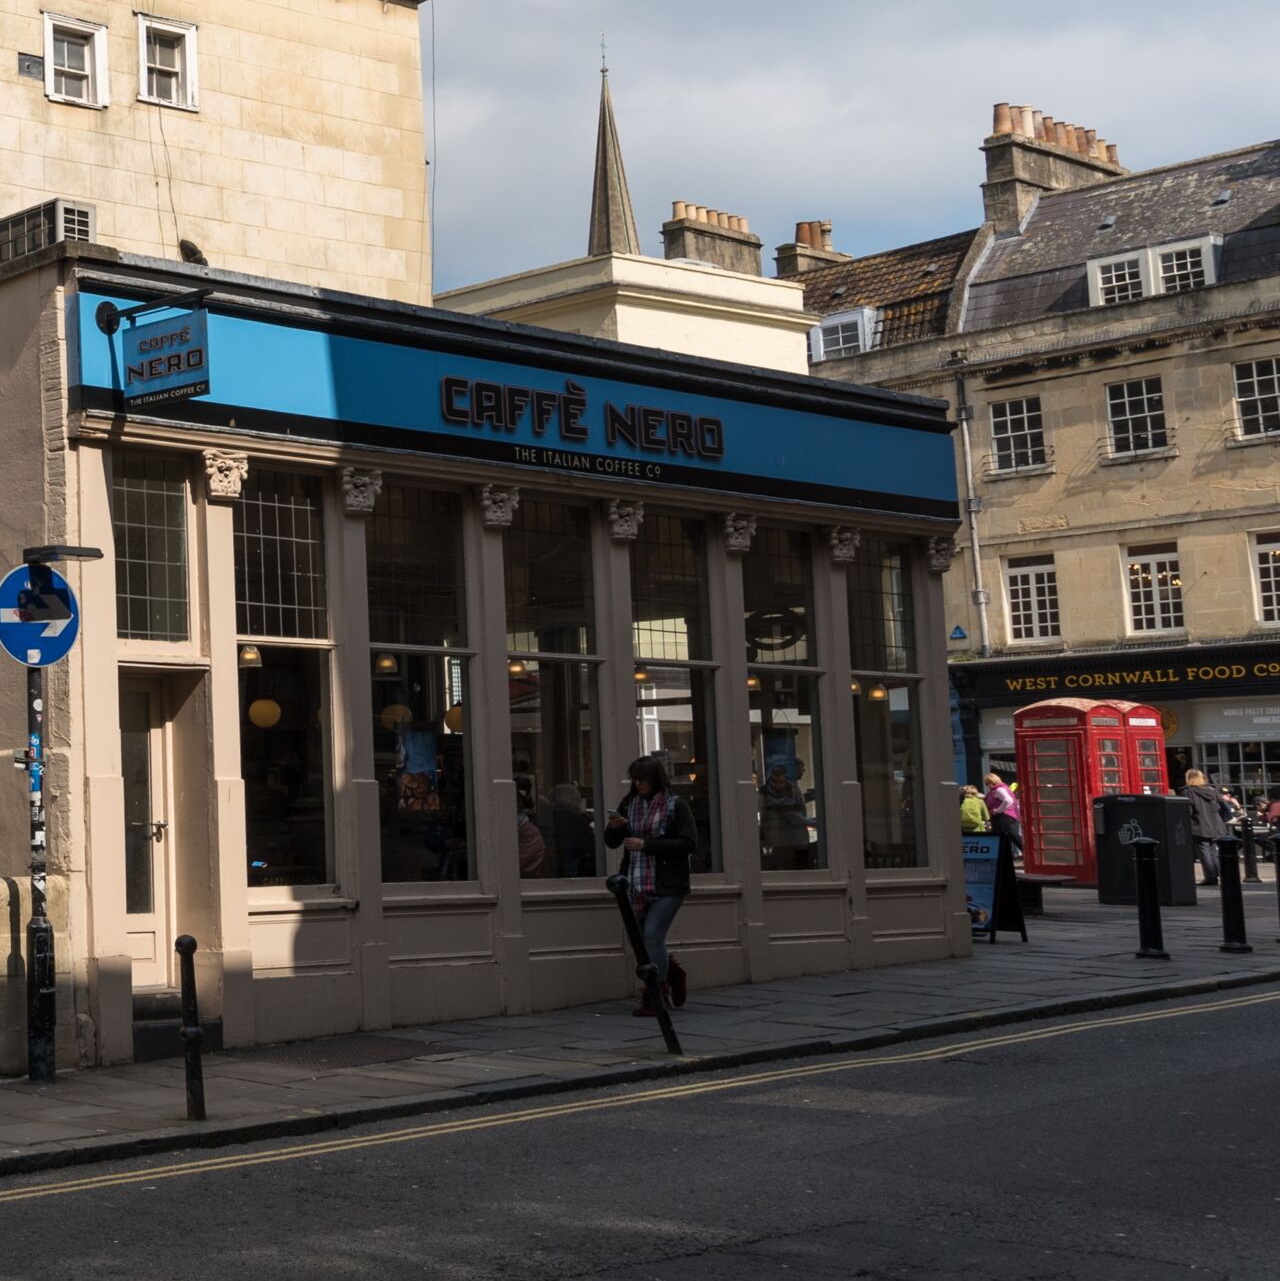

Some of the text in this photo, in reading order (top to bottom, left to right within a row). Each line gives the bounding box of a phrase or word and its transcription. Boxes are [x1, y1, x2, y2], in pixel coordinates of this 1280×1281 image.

[127, 348, 204, 383] NERO
[130, 398, 142, 406] THE
[143, 392, 169, 403] ITALIAN
[170, 386, 195, 398] COFFEE
[441, 375, 724, 458] CAFFÈ NERO
[514, 446, 537, 462] THE
[543, 451, 590, 469] ITALIAN
[596, 457, 641, 476] COFFEE
[1006, 675, 1058, 691] WEST
[1065, 668, 1179, 688] CORNWALL
[1186, 665, 1246, 681] FOOD
[961, 845, 991, 854] ERO
